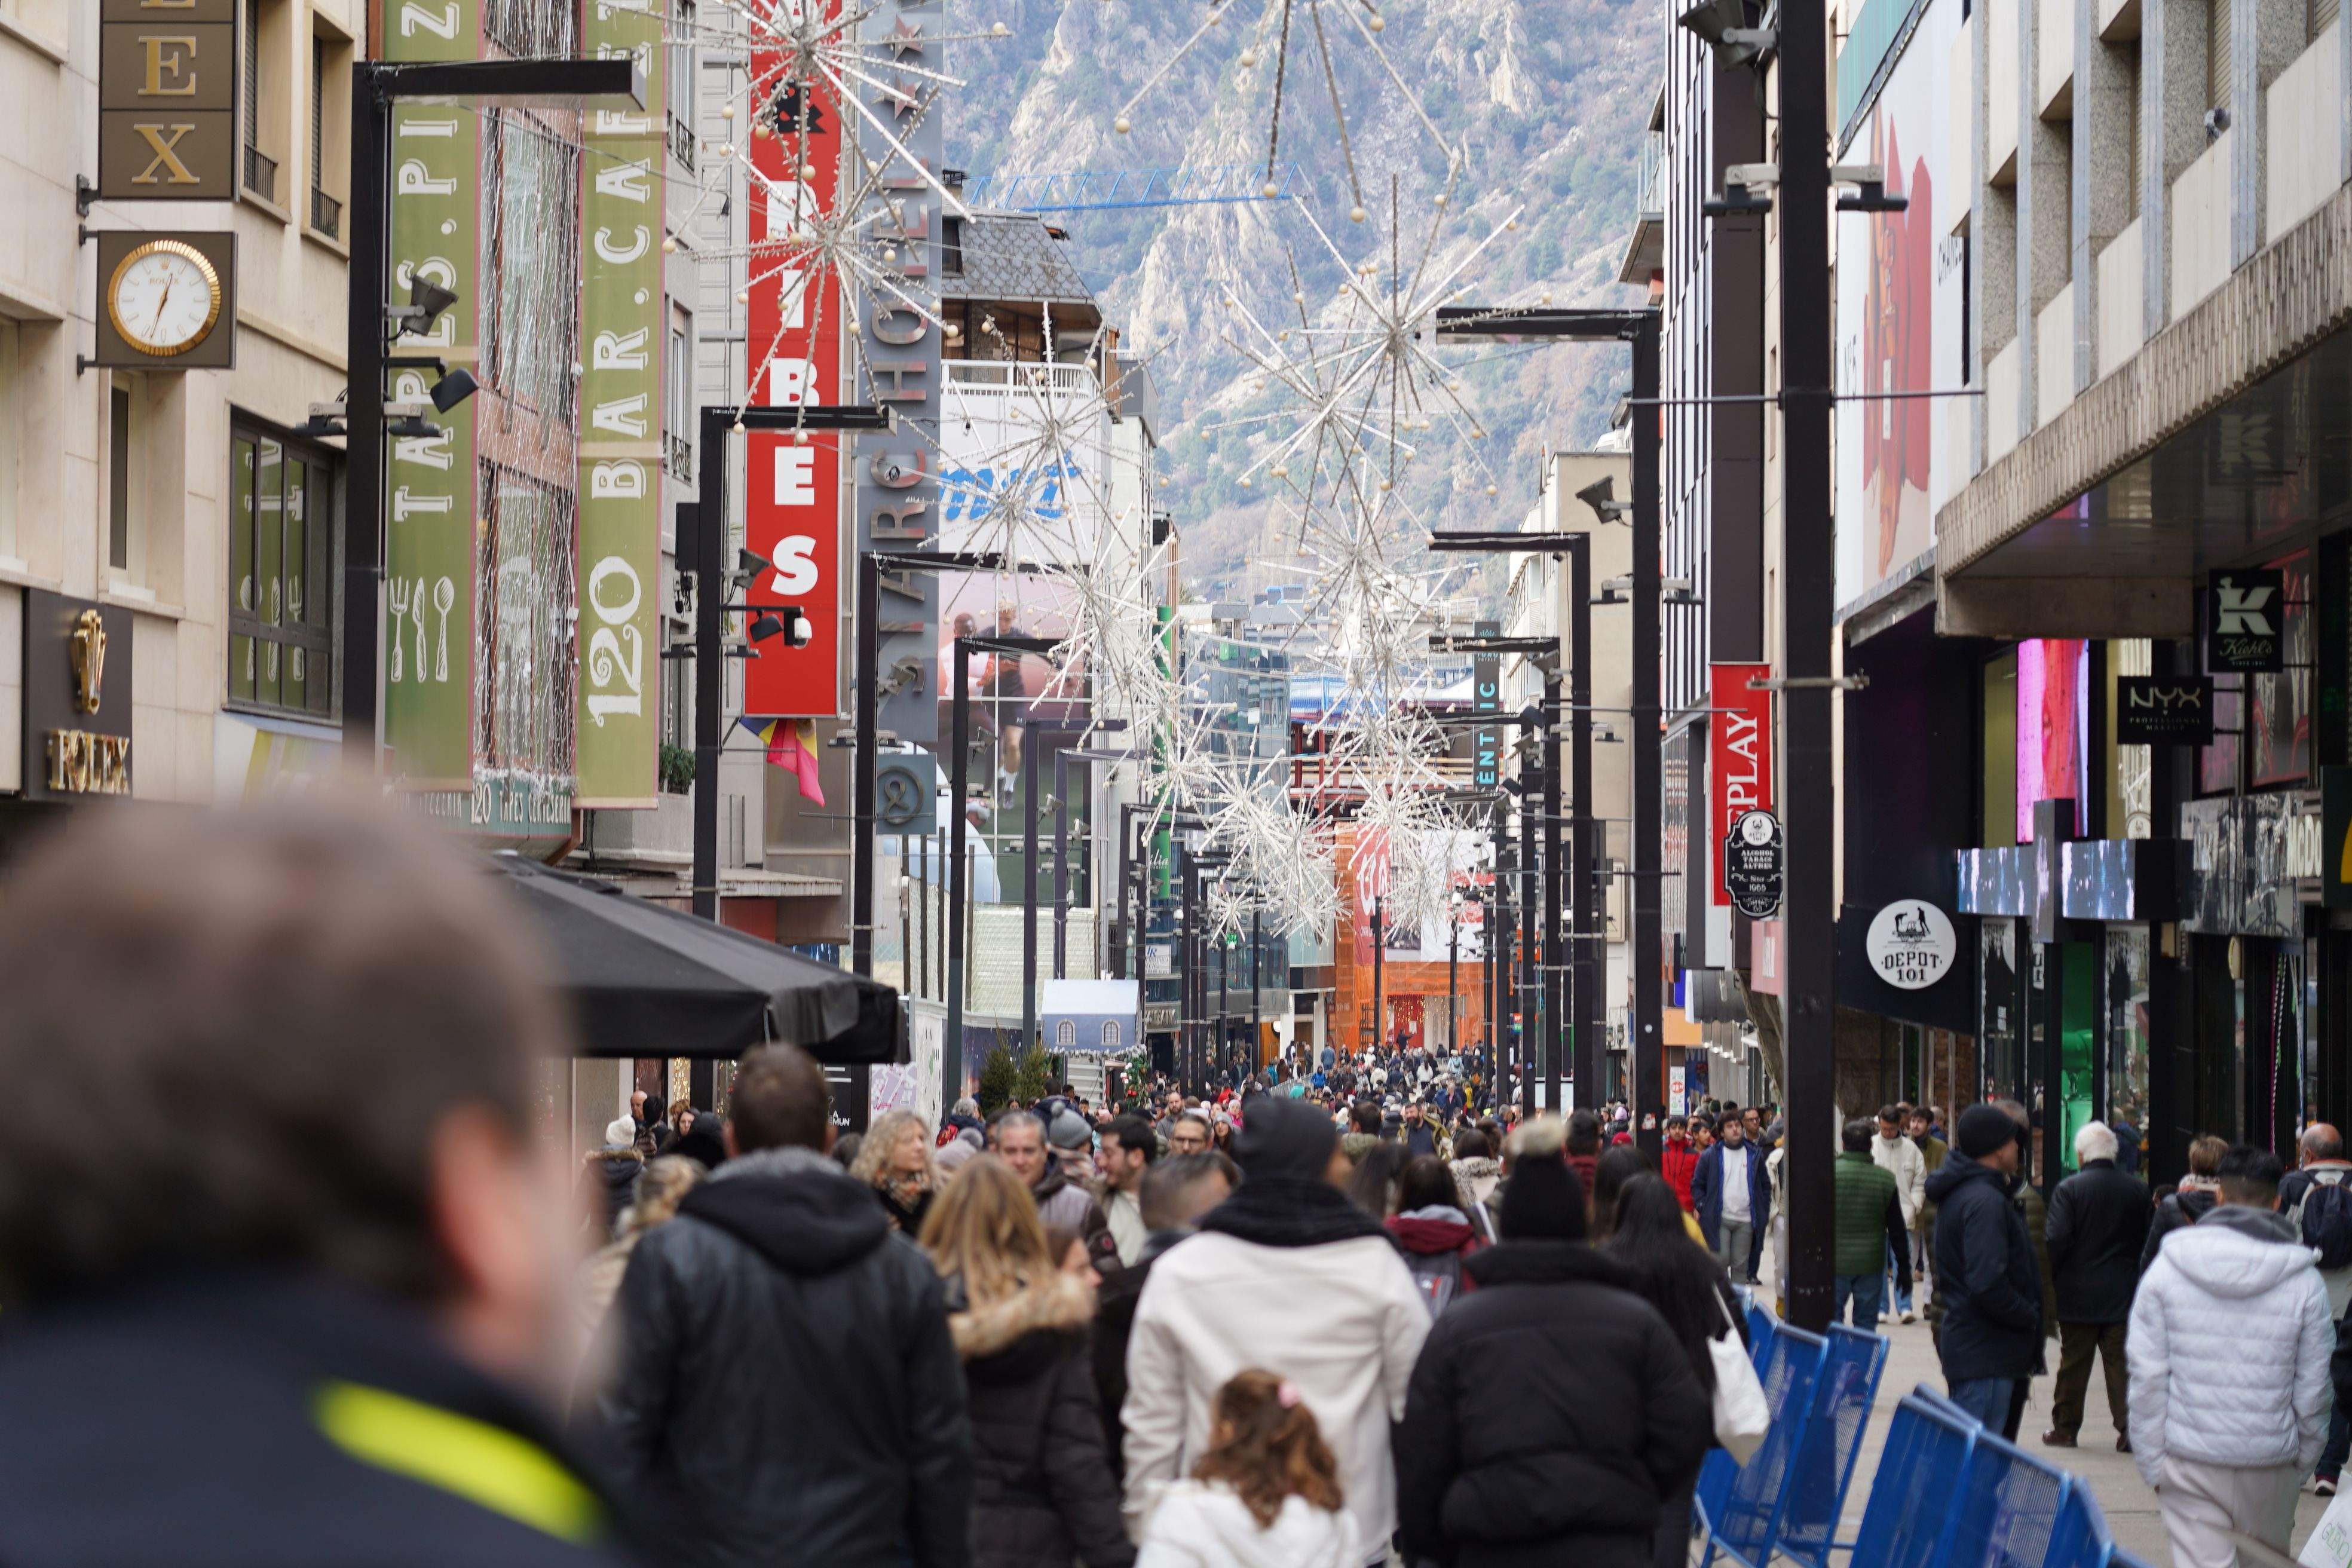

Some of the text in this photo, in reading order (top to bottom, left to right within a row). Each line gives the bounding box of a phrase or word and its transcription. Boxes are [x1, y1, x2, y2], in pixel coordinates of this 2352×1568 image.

[133, 0, 200, 184] EX
[766, 180, 820, 596] RIBES
[585, 556, 642, 728] 120
[2219, 638, 2273, 657] Kiehl's
[2130, 687, 2201, 708] NYX
[49, 728, 130, 794] ROLEX
[470, 782, 492, 825] 120
[1750, 874, 1765, 883] Since
[1884, 951, 1940, 970] DEPOT
[1897, 969, 1928, 982] 101
